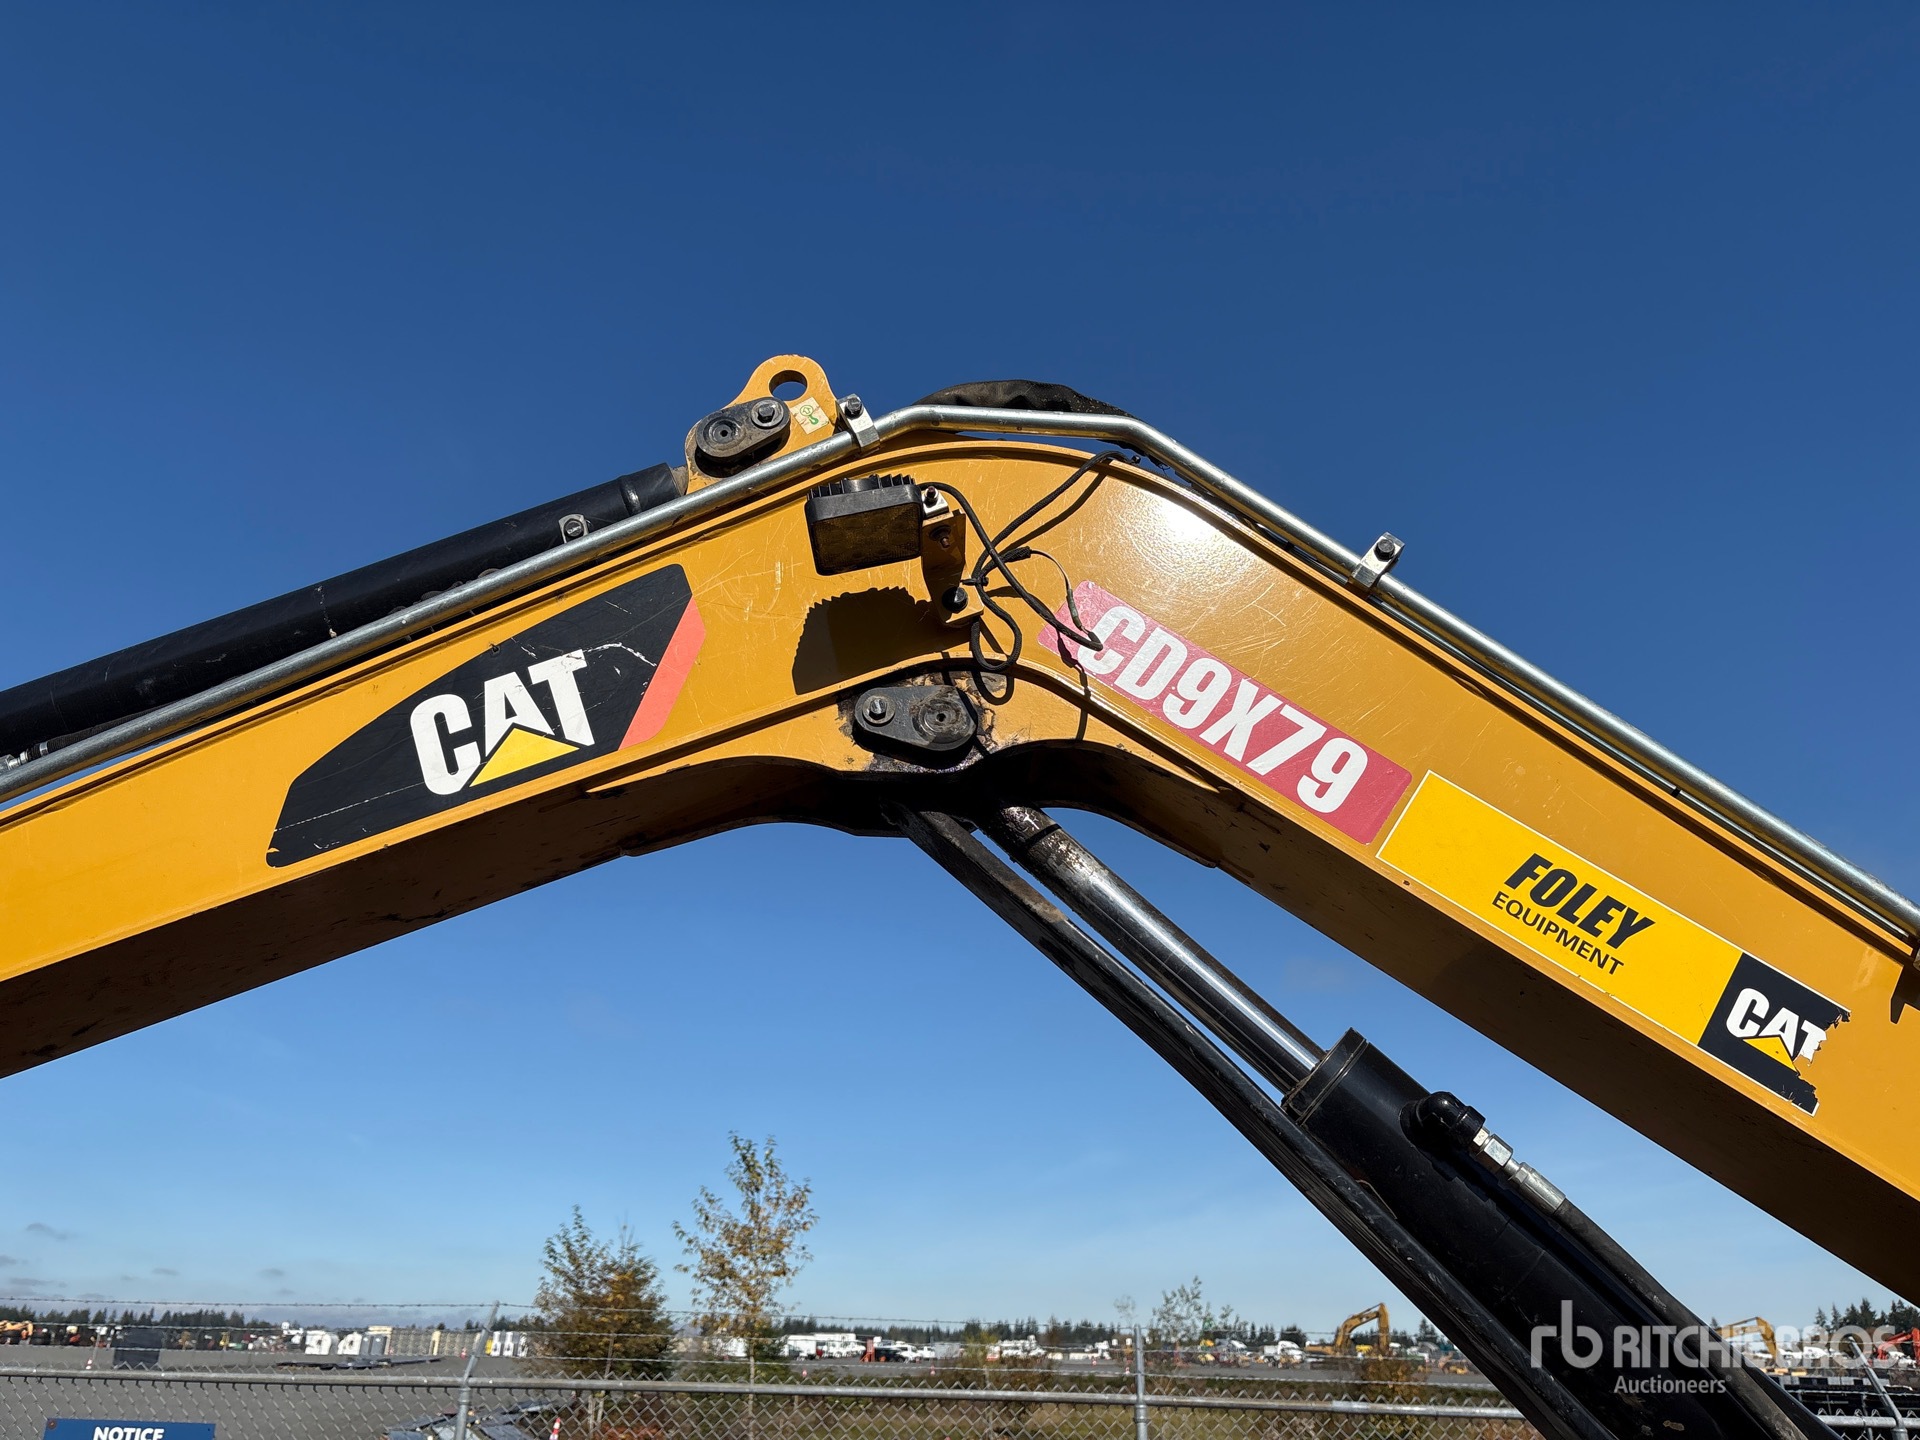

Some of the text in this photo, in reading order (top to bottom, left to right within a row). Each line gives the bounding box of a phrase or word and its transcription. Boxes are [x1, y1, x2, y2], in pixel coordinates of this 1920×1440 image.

[410, 649, 595, 796] CAT
[1077, 605, 1369, 814] CD9X79
[1491, 890, 1625, 976] EQUIPMENT
[1504, 853, 1656, 950] FOLEY
[1726, 987, 1827, 1064] CAT
[93, 1426, 165, 1440] NOTICE
